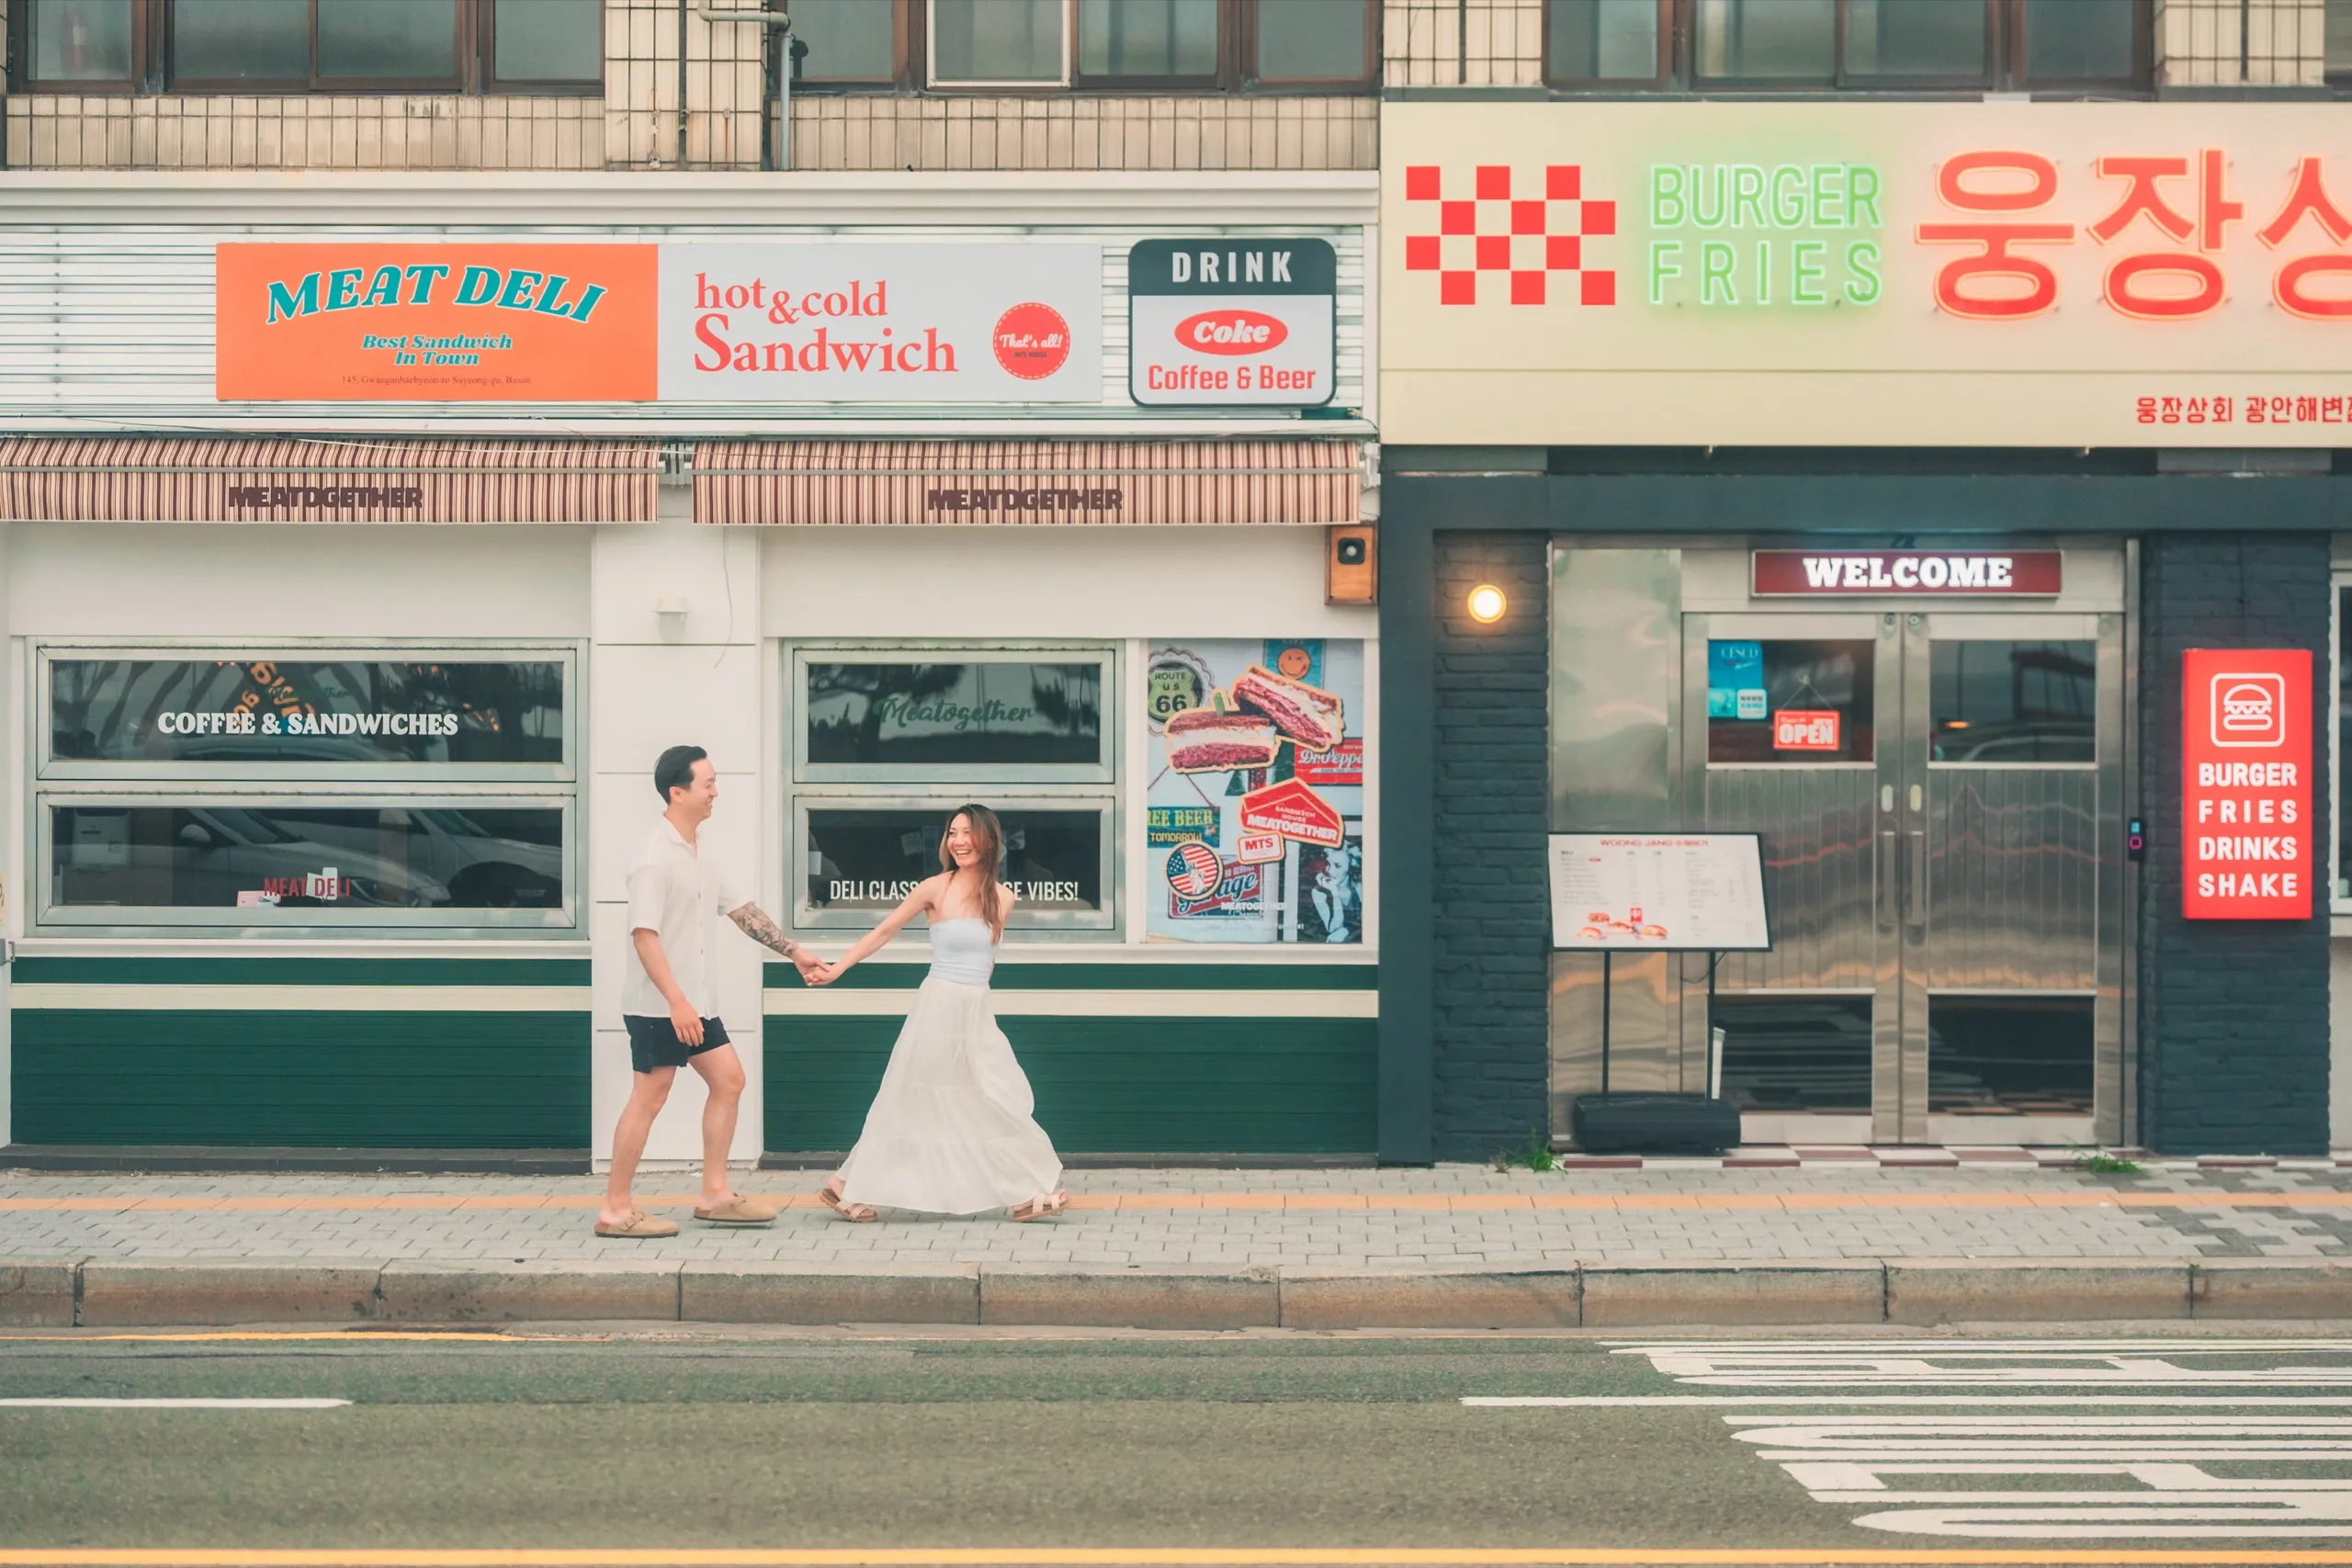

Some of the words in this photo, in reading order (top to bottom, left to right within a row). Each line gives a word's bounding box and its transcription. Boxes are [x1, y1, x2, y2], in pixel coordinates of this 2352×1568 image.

[1651, 164, 1883, 230] BURGER
[1171, 251, 1292, 283] DRINK
[1650, 240, 1883, 306] FRIES
[266, 263, 450, 324] MEAT
[453, 264, 608, 324] DELI
[361, 333, 409, 350] Best
[411, 333, 513, 350] Sandwich
[694, 313, 959, 372] Sandwich
[999, 333, 1038, 348] That's
[1040, 333, 1063, 348] all!
[1193, 319, 1271, 344] Coke
[394, 351, 417, 366] In
[422, 351, 480, 366] Town
[342, 375, 359, 385] 145,
[1148, 365, 1228, 389] Coffee
[1237, 365, 1251, 389] &
[1260, 365, 1316, 389] Beer
[2136, 396, 2233, 423] 웅장상회
[2245, 396, 2352, 423] 광안해변
[229, 487, 424, 508] MEATOGETHER
[928, 488, 1123, 510] MEATOGETHER
[1803, 557, 2013, 588] WELCOME
[1154, 671, 1187, 680] ROUTE
[873, 697, 1034, 730] Meatogether
[1156, 694, 1187, 713] 66
[158, 712, 255, 734] COFFEE
[262, 713, 281, 734] &
[288, 712, 458, 735] SANDWICHES
[1779, 723, 1834, 745] OPEN
[2199, 762, 2298, 786] BURGER
[1174, 809, 1214, 826] BEER
[2199, 799, 2298, 823] FRIES
[1247, 814, 1338, 841] MEATOGETHER
[1244, 838, 1273, 852] MTS
[2199, 837, 2298, 861] DRINKS
[264, 877, 308, 897] MEAT
[314, 877, 351, 897] DELI
[831, 880, 863, 900] DELI
[1027, 881, 1079, 901] VIBES!
[2199, 874, 2298, 897] SHAKE
